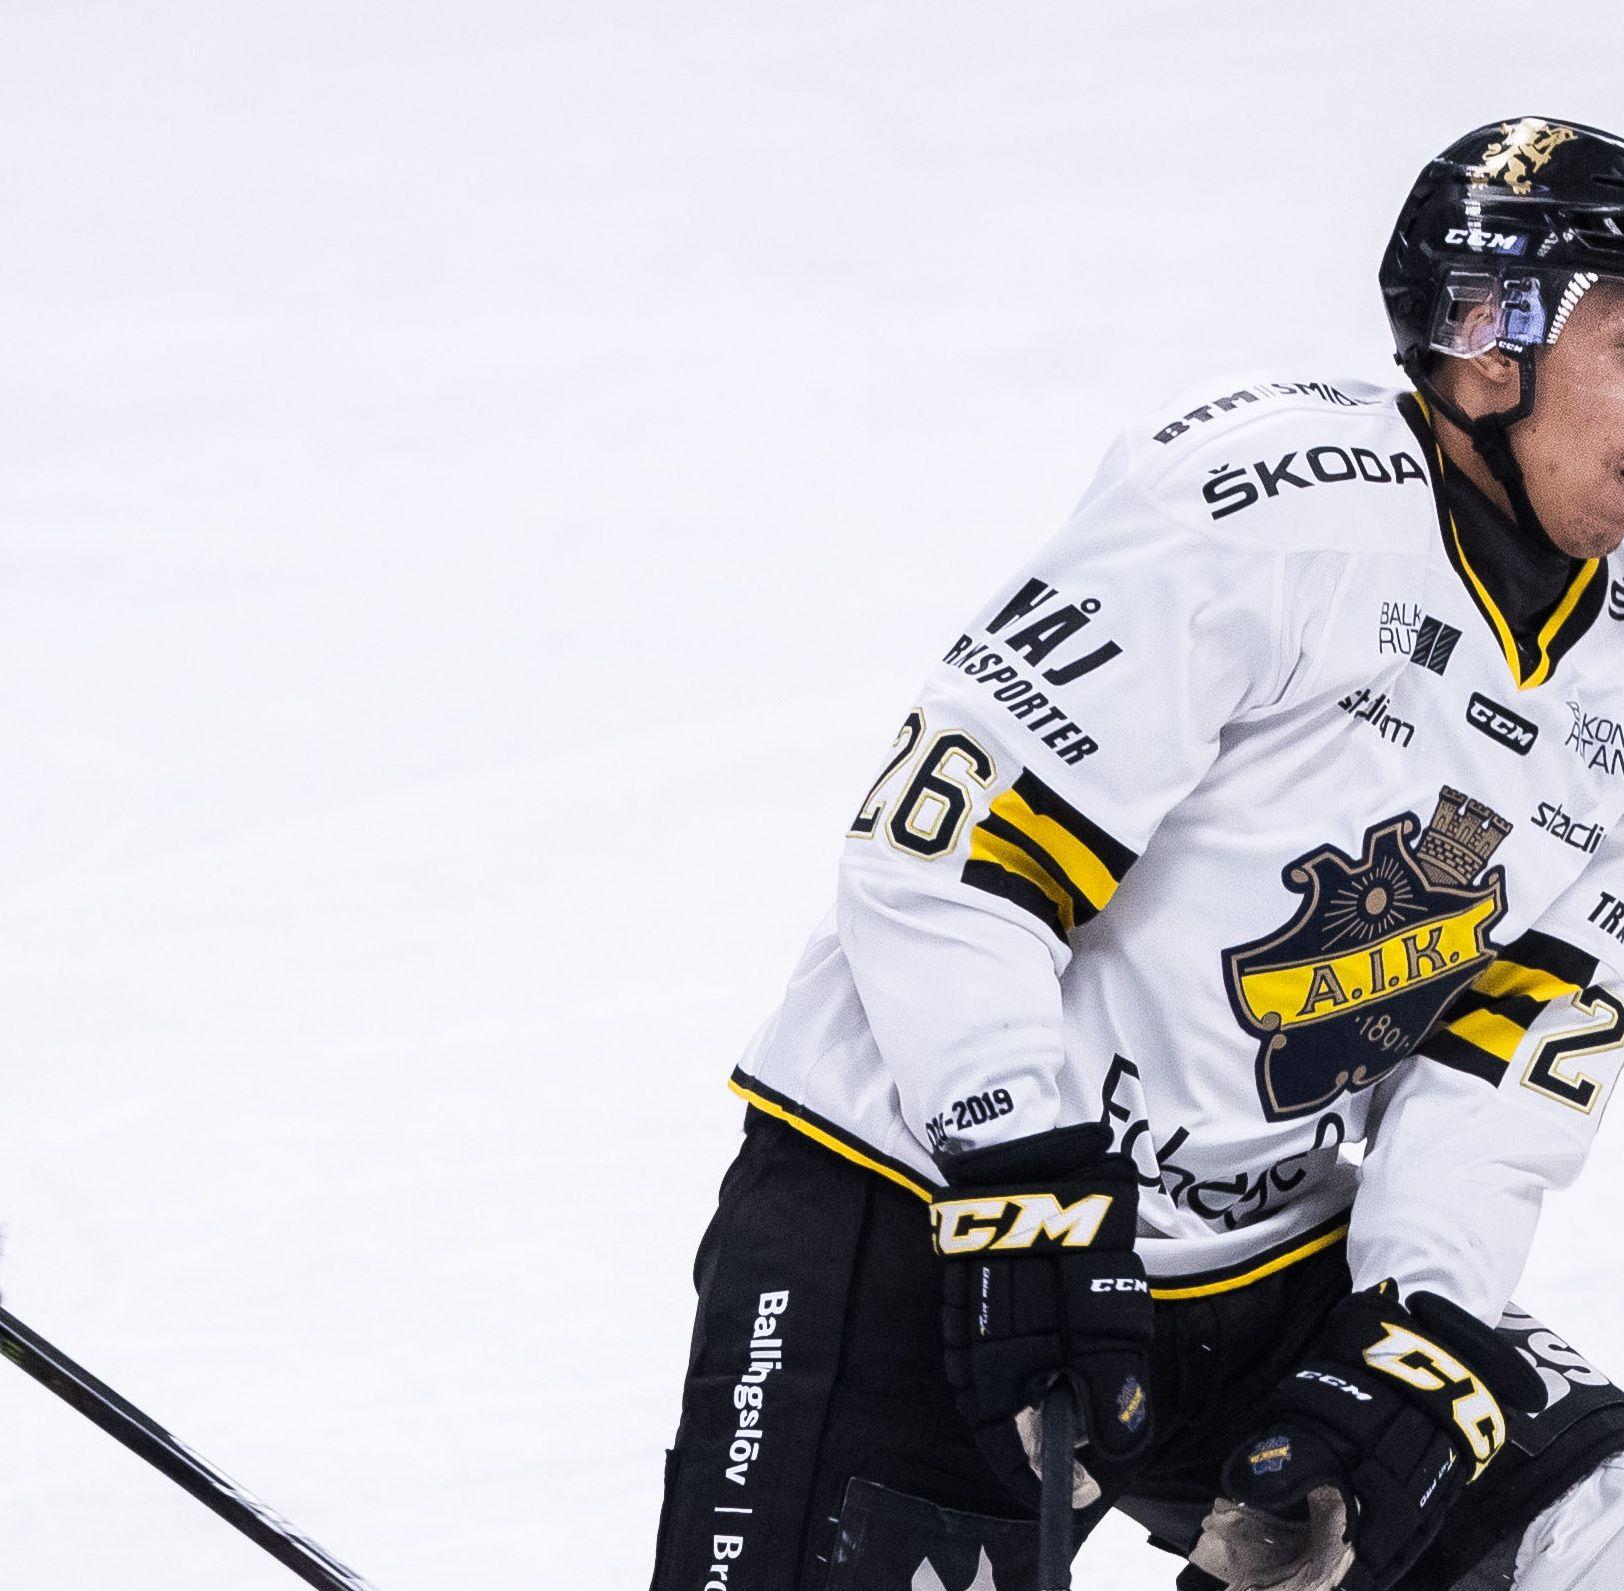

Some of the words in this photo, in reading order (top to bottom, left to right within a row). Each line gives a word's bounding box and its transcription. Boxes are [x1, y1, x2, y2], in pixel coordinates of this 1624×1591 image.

[1444, 228, 1518, 250] CCM
[1152, 389, 1260, 445] BTM
[1201, 445, 1429, 520] ŠKODA
[1469, 701, 1535, 749] CCM
[846, 706, 998, 862] 26
[930, 1193, 1114, 1255] CM
[1361, 1320, 1506, 1485] CC
